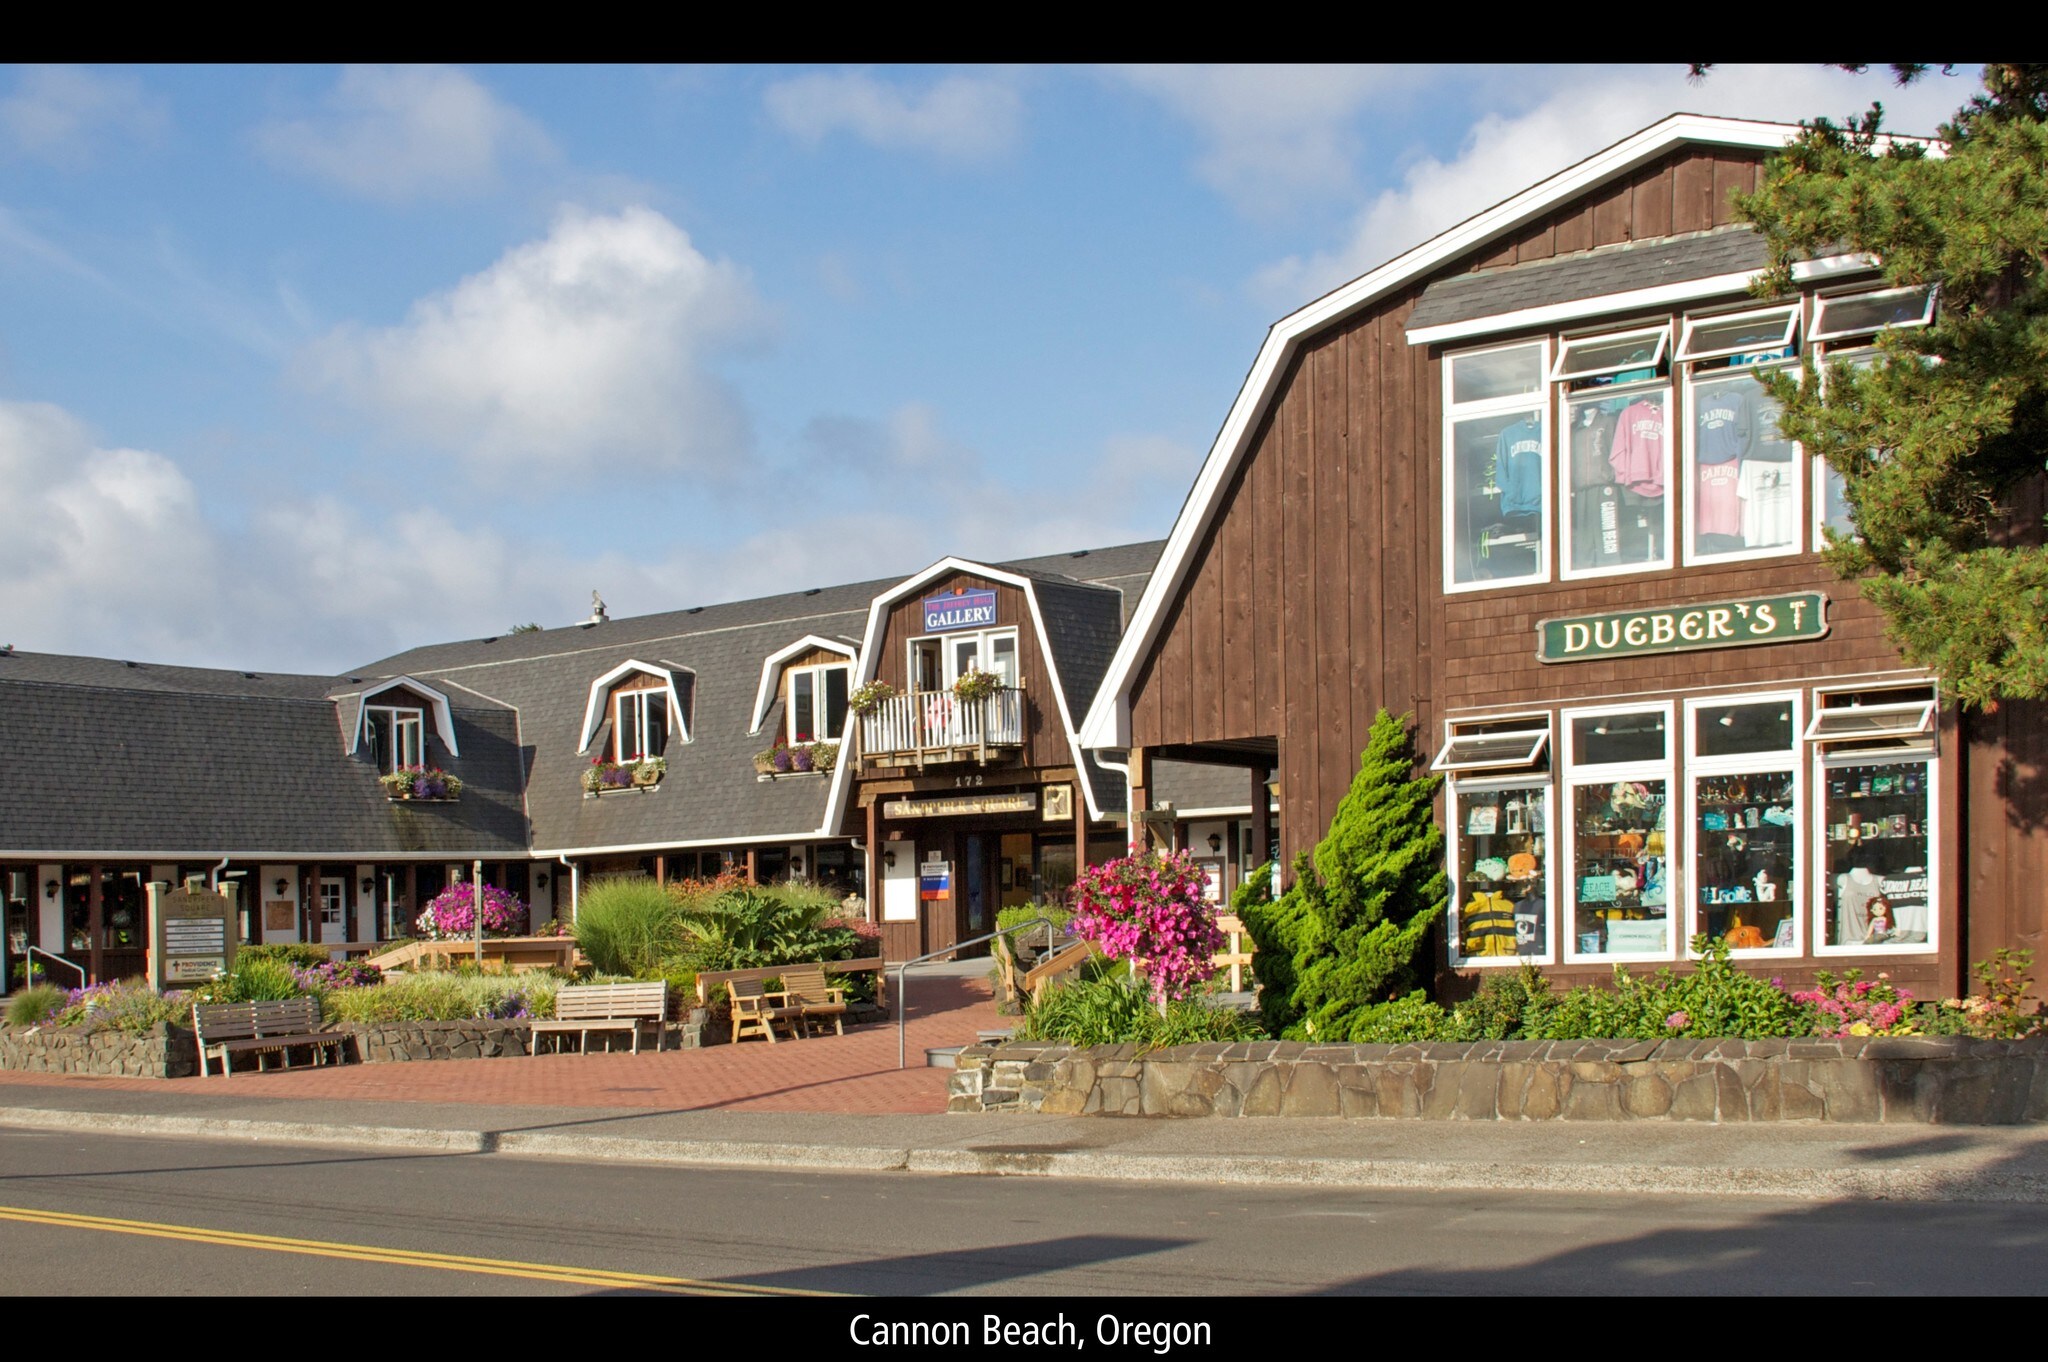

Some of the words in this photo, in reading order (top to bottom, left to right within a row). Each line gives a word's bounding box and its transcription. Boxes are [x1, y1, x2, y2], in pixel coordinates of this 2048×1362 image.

[1602, 530, 1618, 554] BEACH
[927, 605, 993, 628] GALLERY
[1563, 603, 1777, 653] DUEBER'S
[955, 775, 983, 787] 172
[894, 799, 967, 816] SANDPIPER
[972, 795, 1025, 813] SQUARE
[1584, 882, 1610, 893] BEACH
[173, 895, 215, 904] SANDPIPER
[180, 904, 210, 912] SQUARE
